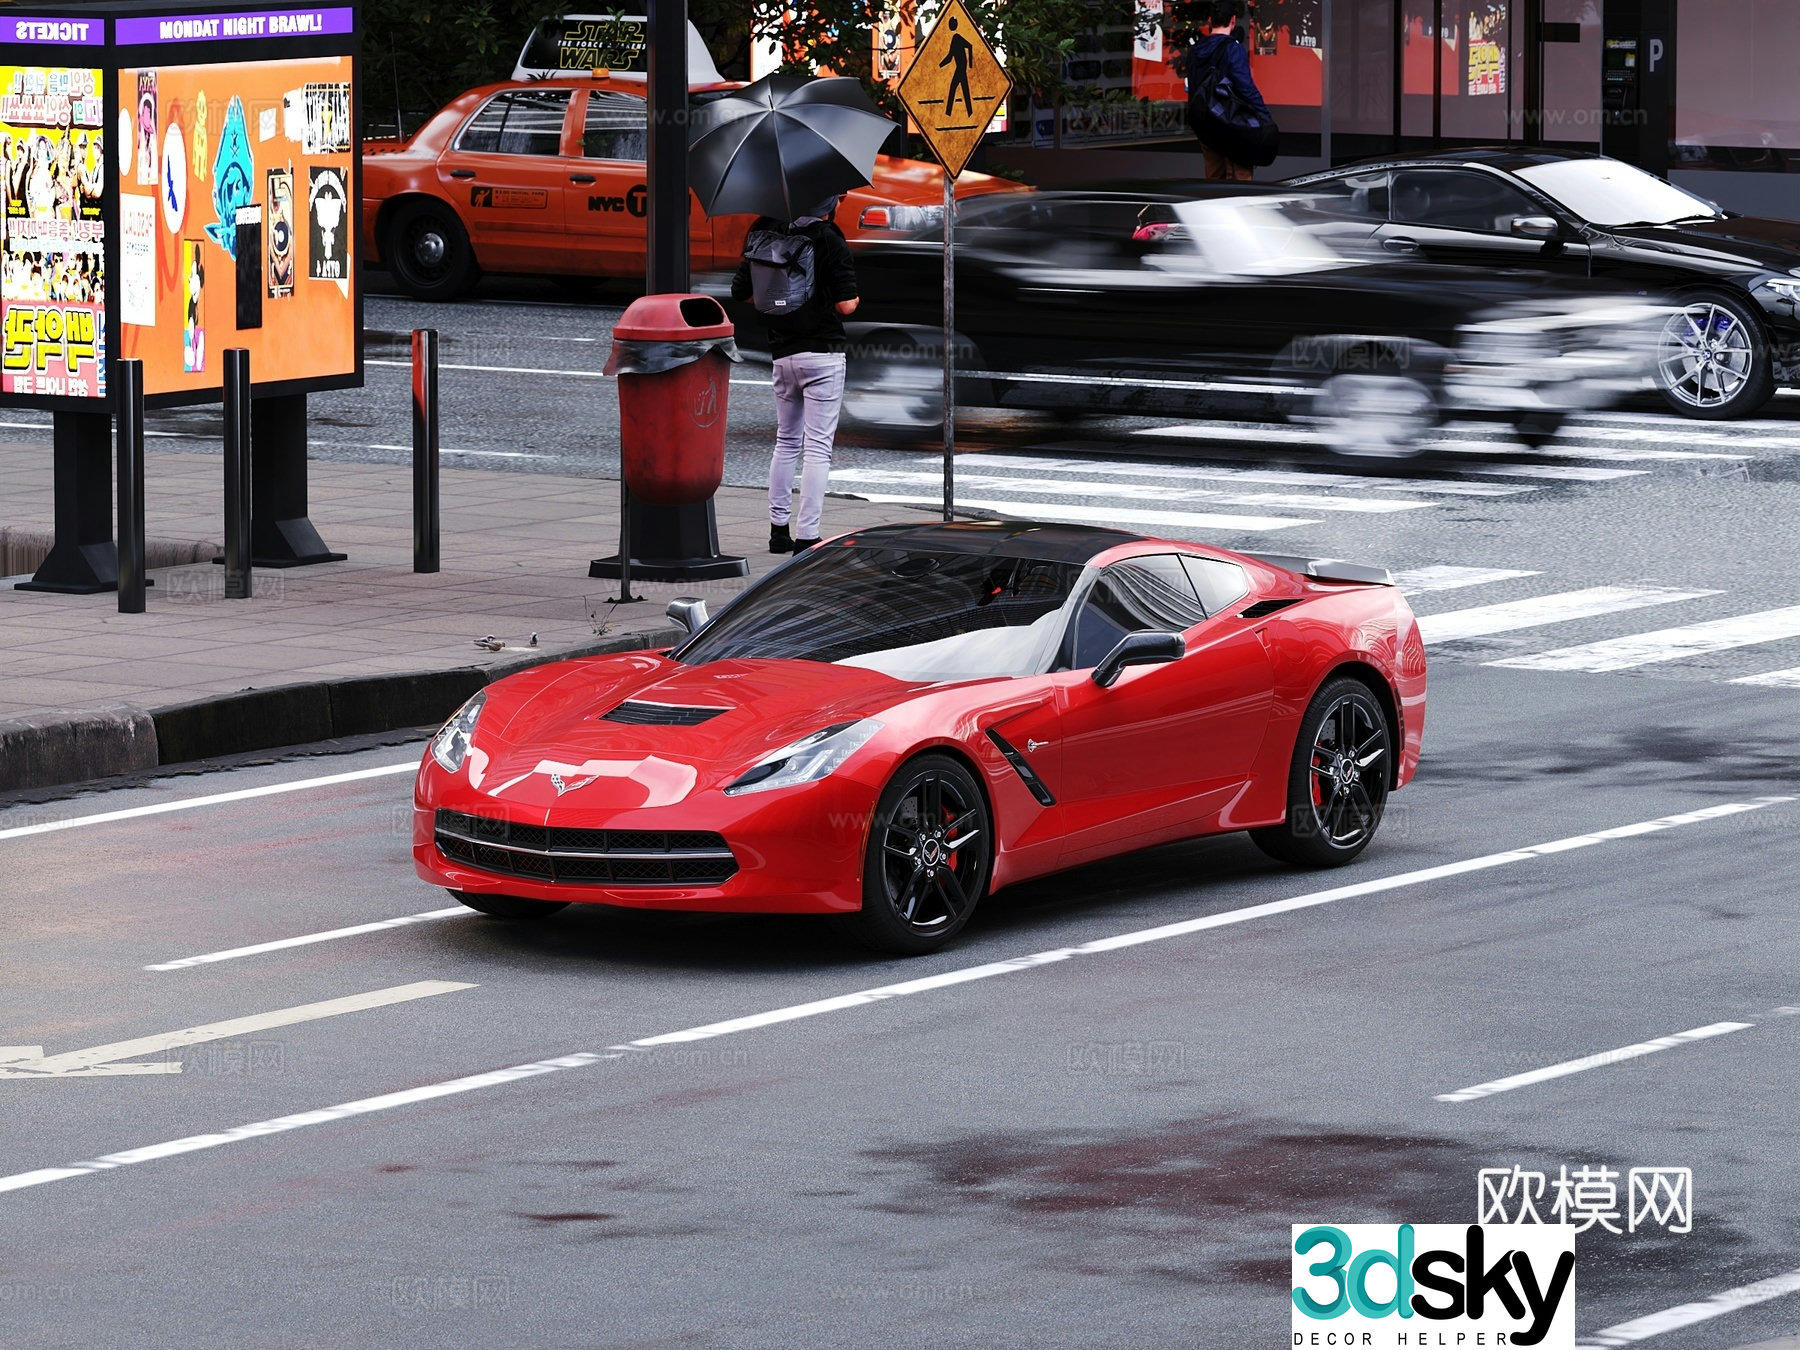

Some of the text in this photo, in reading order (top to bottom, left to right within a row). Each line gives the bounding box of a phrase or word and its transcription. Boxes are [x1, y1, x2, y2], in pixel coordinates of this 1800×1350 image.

[160, 14, 323, 40] MONDAT NIGHT BRAWL!
[560, 47, 640, 70] WARS
[1649, 38, 1664, 72] P
[588, 196, 625, 212] NYC
